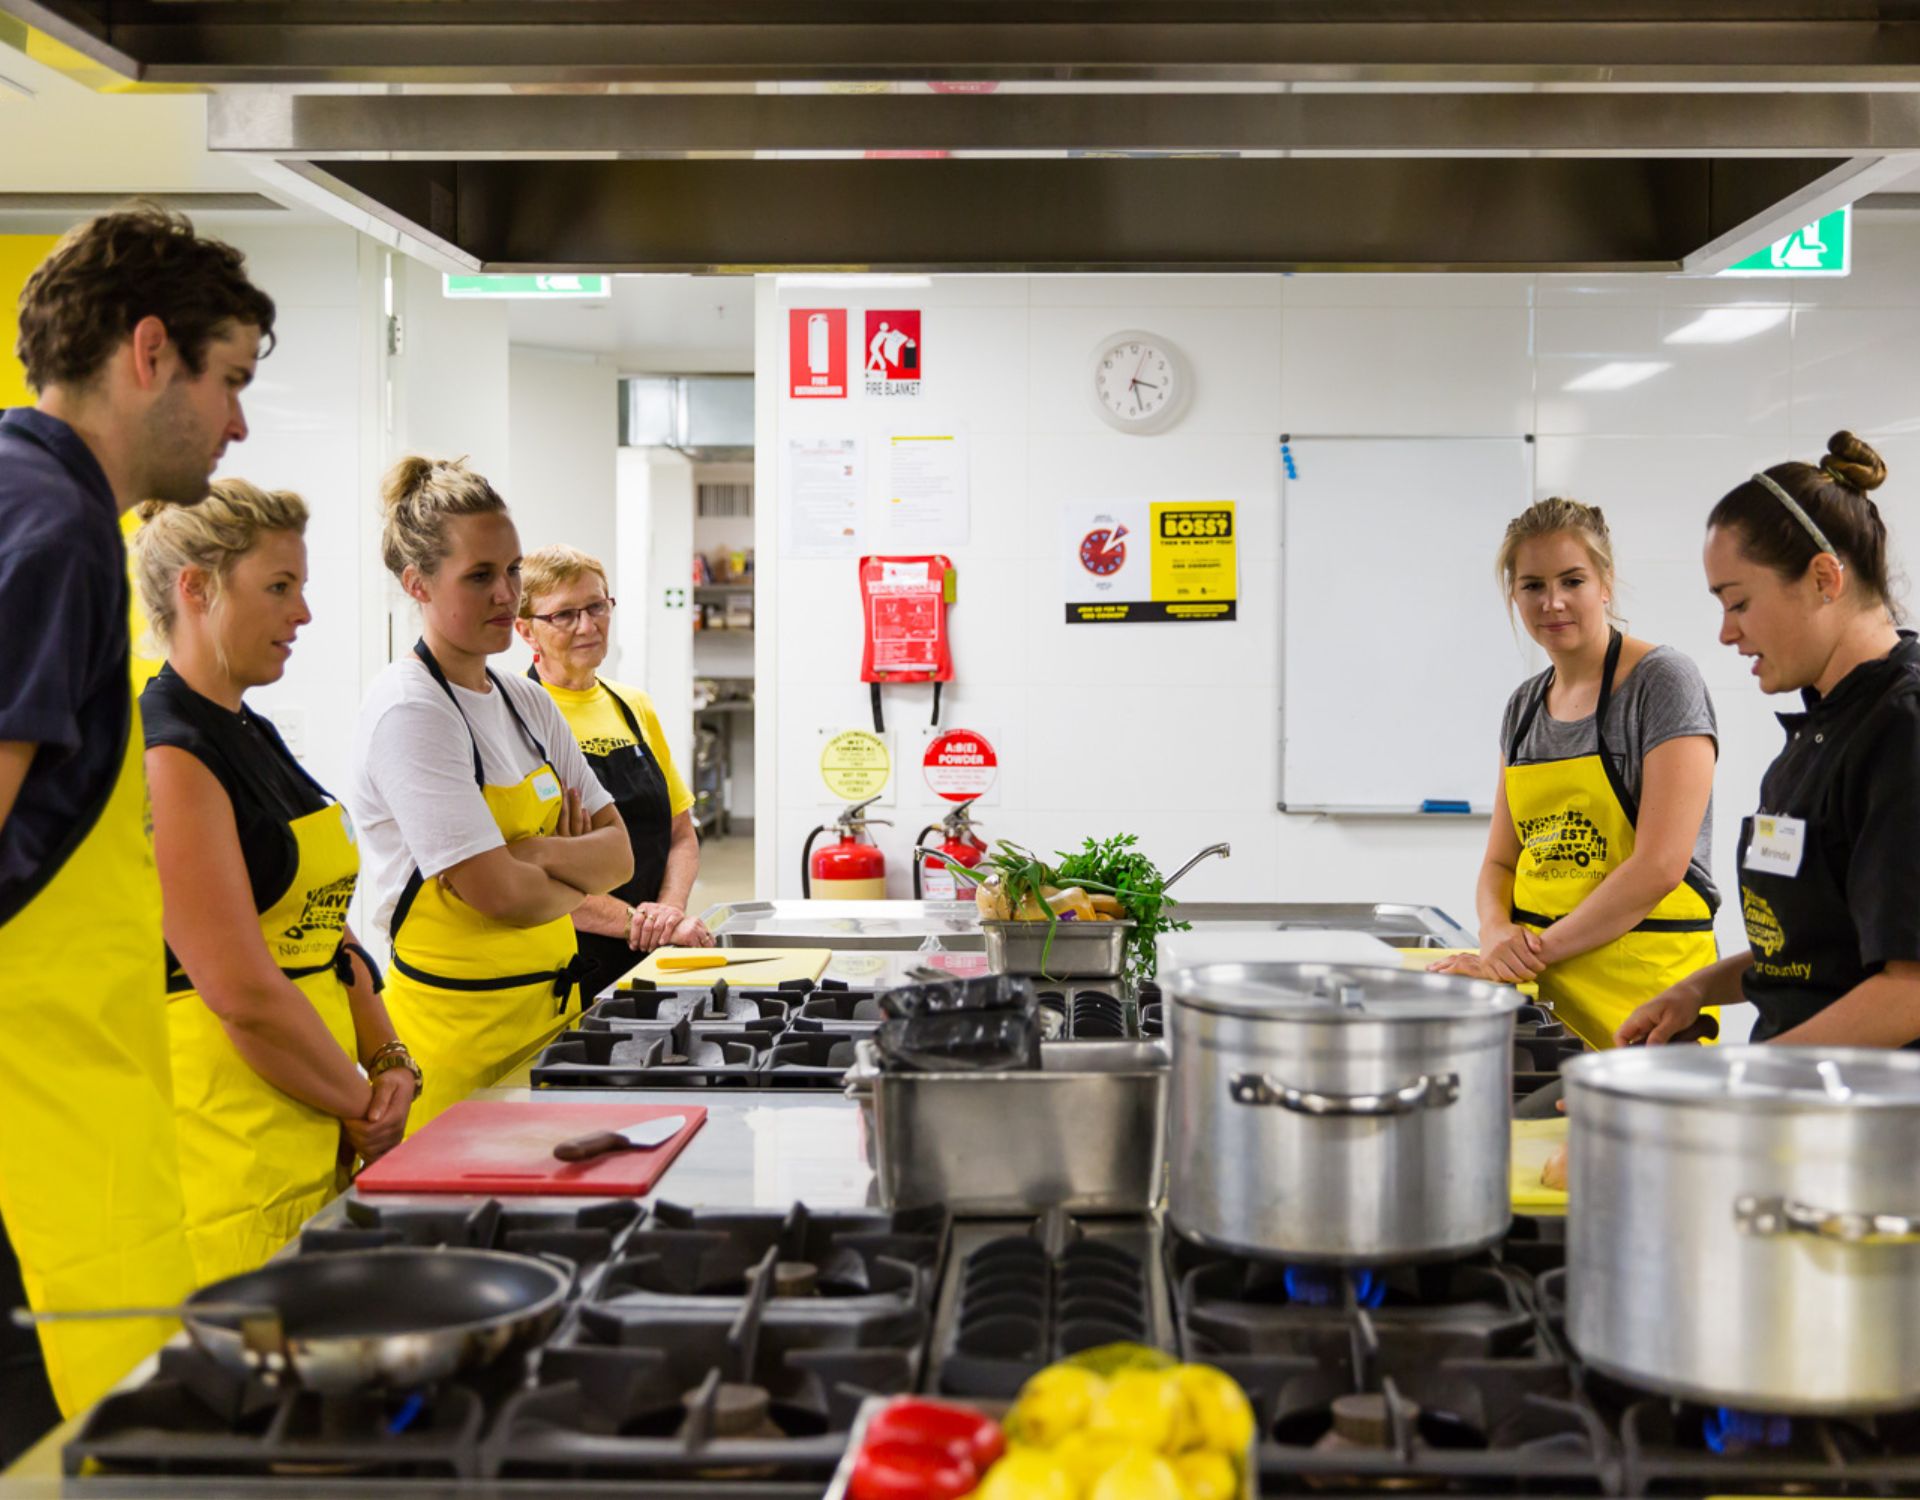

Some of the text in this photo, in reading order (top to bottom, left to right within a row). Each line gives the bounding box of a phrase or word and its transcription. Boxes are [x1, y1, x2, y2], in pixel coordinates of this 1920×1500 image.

[885, 381, 921, 396] BLANKET
[1164, 518, 1228, 536] BOSS?
[938, 754, 985, 766] POWDER
[1551, 868, 1567, 879] Our
[1764, 962, 1811, 980] country
